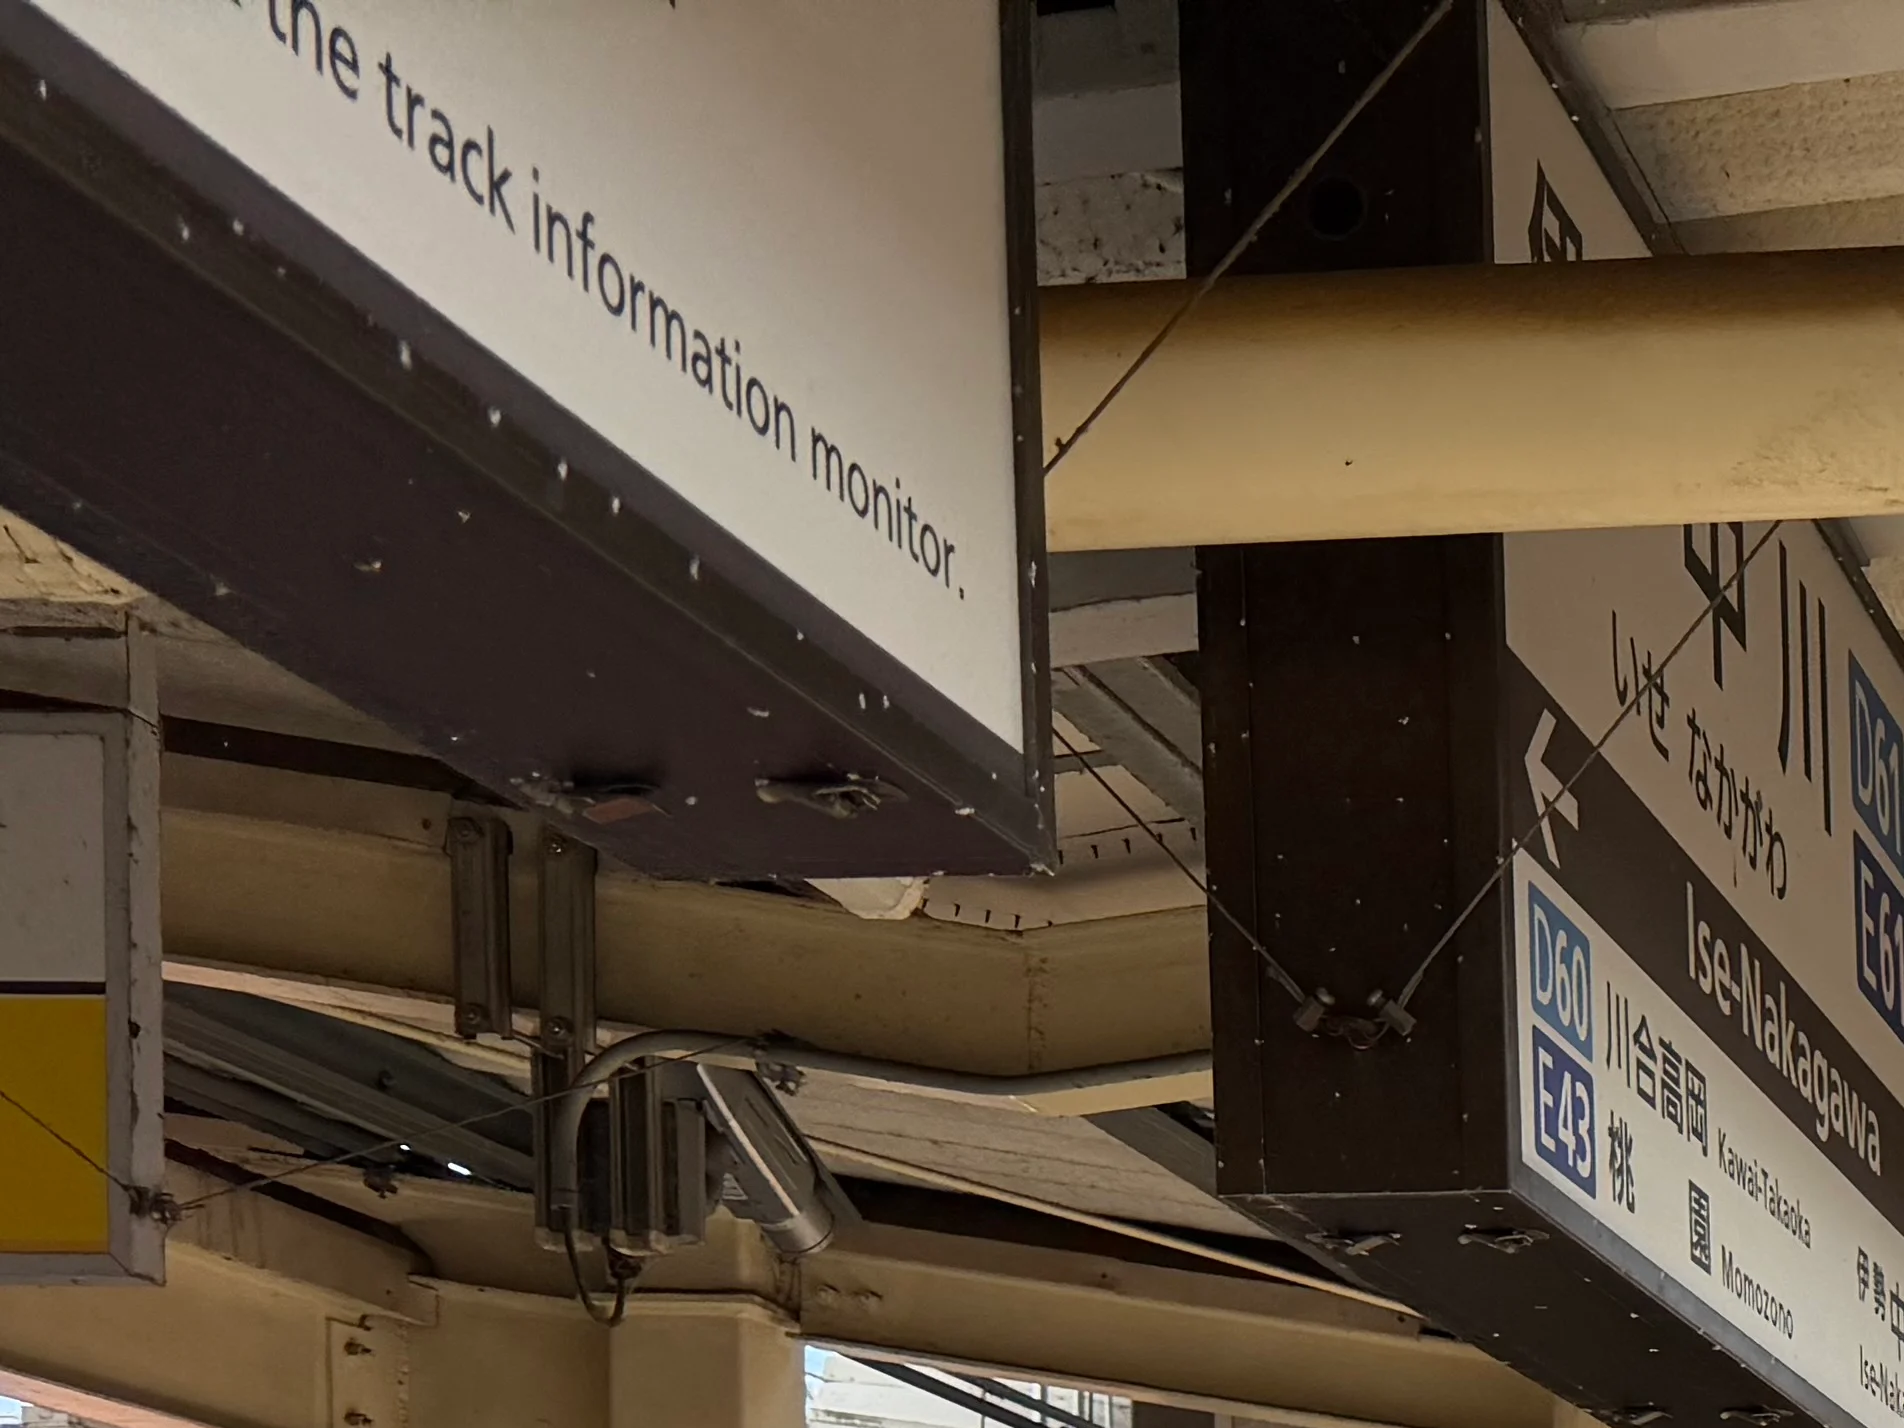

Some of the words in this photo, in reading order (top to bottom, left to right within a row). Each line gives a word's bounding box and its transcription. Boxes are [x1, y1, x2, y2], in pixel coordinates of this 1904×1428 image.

[378, 51, 516, 236] track
[531, 166, 797, 463] information
[810, 426, 965, 600] monitor.
[1686, 706, 1789, 901] なかがわ
[1854, 684, 1902, 858] D61
[1534, 904, 1588, 1042] D60
[1685, 881, 1882, 1177] Ise-Nakagawa
[1538, 1053, 1592, 1180] E43
[1605, 981, 1709, 1158] 川合高岡
[1717, 1127, 1812, 1250] Kawai-Takaoka
[1720, 1244, 1795, 1341] Momozono
